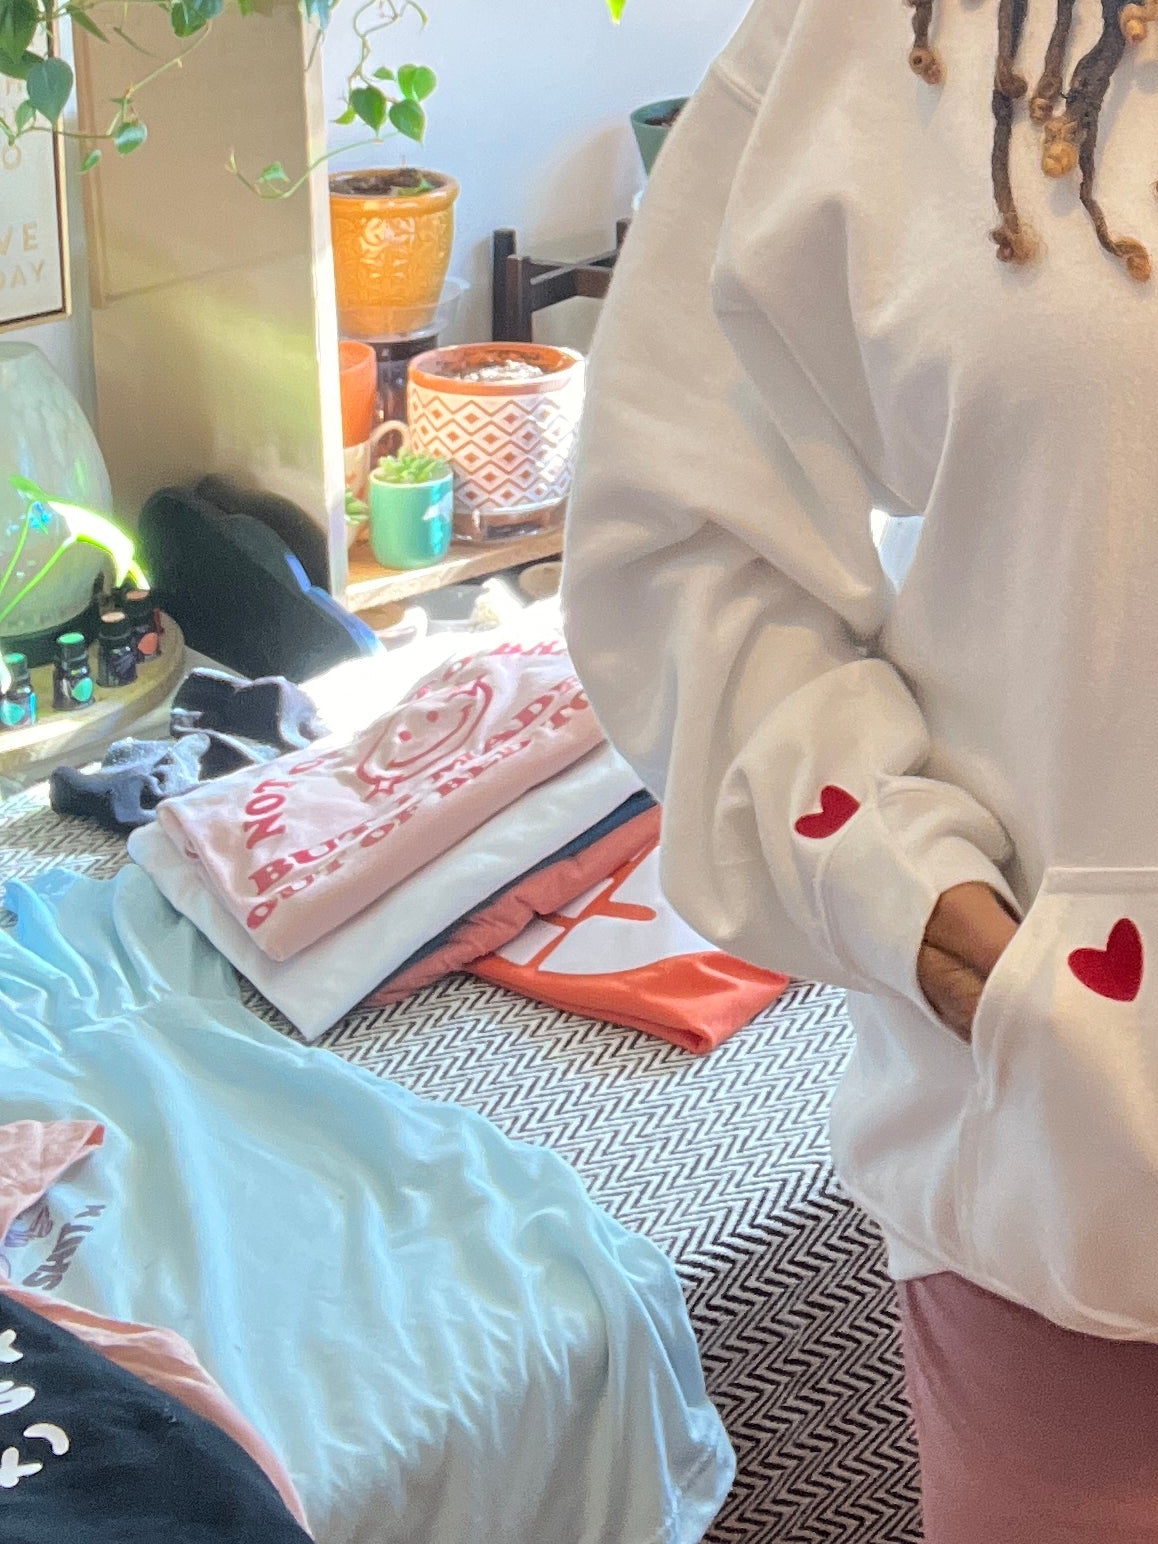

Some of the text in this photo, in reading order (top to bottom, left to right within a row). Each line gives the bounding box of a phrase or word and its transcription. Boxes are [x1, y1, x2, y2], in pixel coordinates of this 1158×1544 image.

[243, 778, 296, 850] NOT
[246, 855, 346, 930] OUT
[360, 805, 419, 849] OF
[248, 820, 372, 896] BUT
